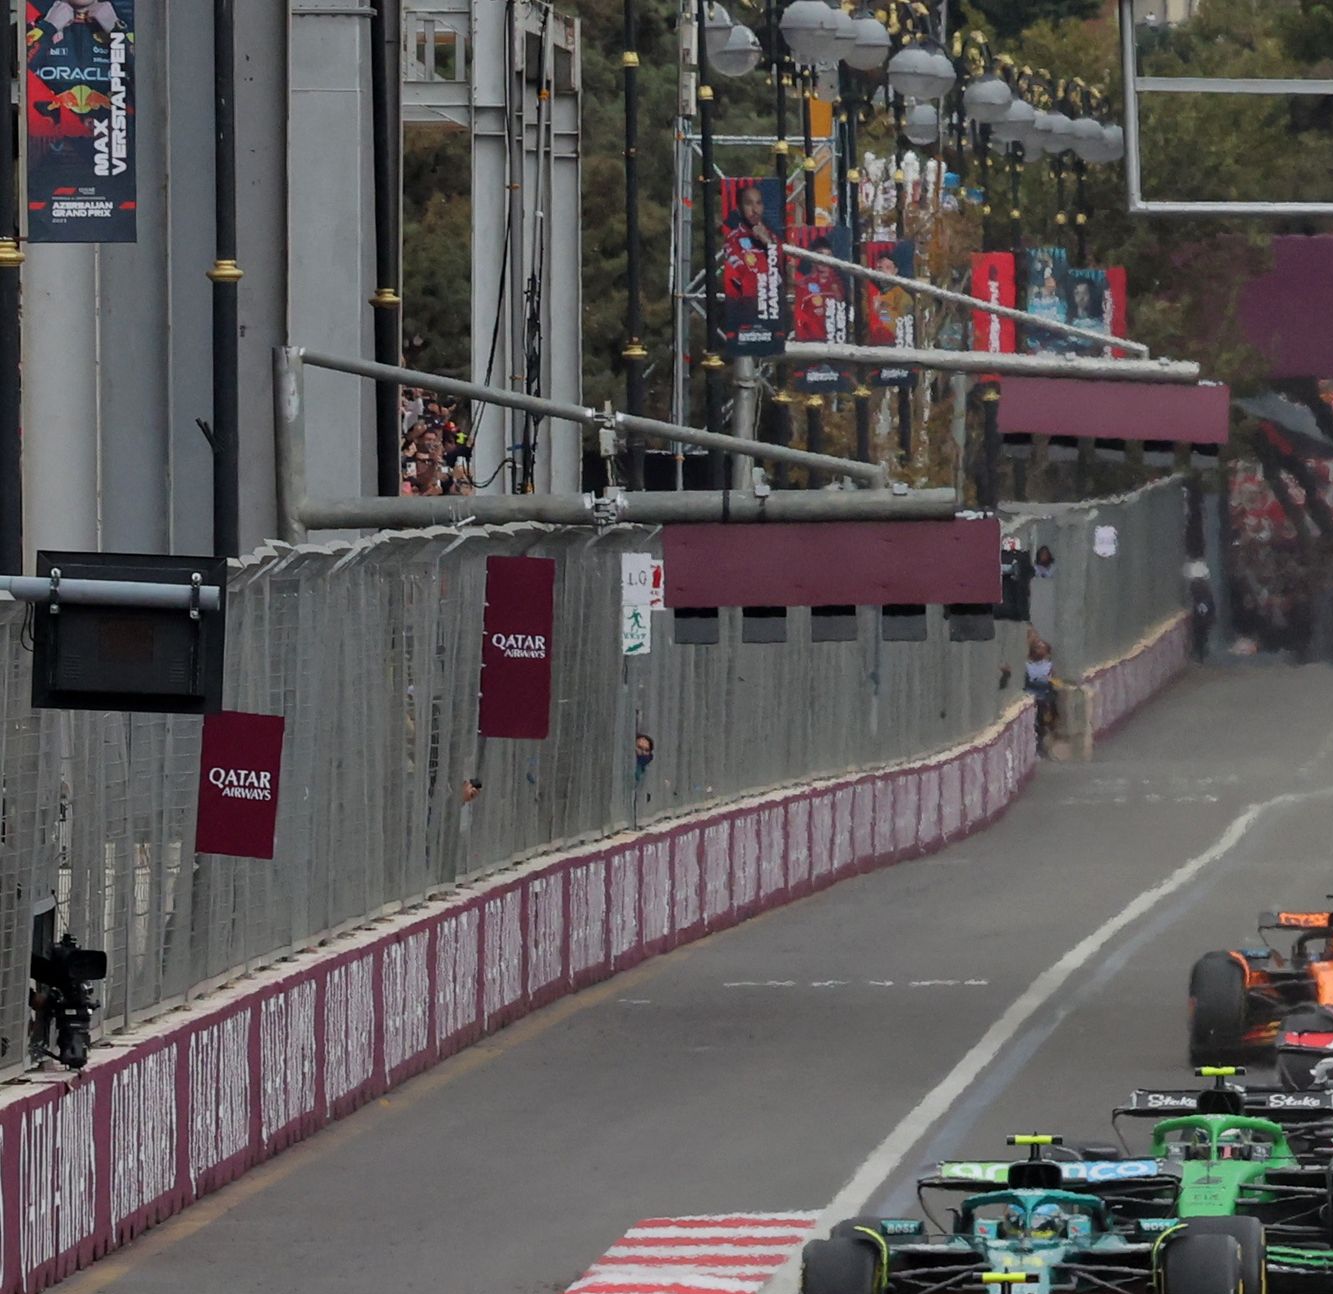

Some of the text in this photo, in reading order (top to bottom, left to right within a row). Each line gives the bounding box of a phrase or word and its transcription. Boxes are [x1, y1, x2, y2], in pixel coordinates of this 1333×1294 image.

[110, 32, 128, 176] VERSTAPPEN
[94, 118, 109, 176] MAX
[768, 243, 779, 320] HAMILTON
[758, 272, 768, 319] LEWIS
[491, 633, 546, 650] QATAR
[504, 648, 546, 659] AIRWAYS
[208, 767, 272, 789] QATAR
[222, 786, 272, 801] AIRWAYS
[1147, 1093, 1321, 1107] Stake Stake
[886, 1223, 917, 1234] BOSS
